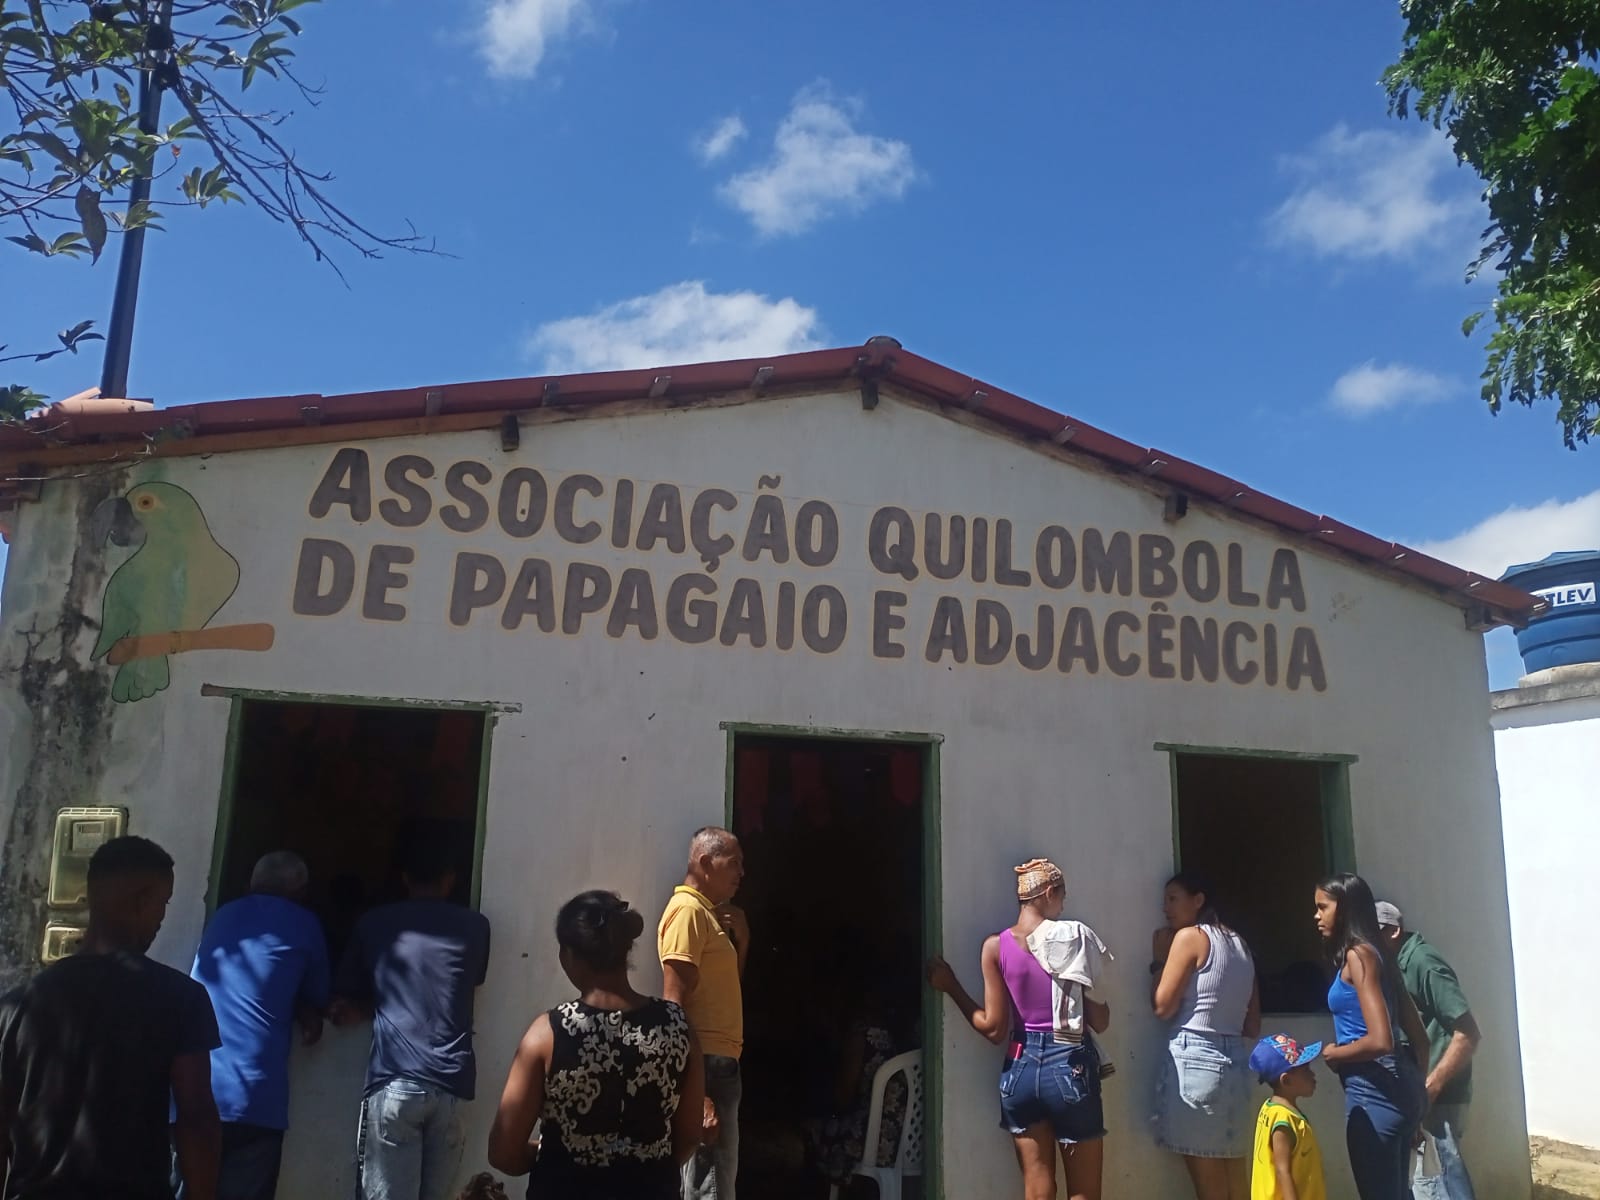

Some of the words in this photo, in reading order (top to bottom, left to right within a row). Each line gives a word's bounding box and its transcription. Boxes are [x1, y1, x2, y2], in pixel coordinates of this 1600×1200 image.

[308, 447, 839, 573] ASSOCIAÇÃO
[868, 506, 1307, 612] QUILOMBOLA
[1544, 587, 1593, 606] TLEV
[293, 537, 415, 622] DE
[449, 551, 848, 654] PAPAGAIO
[873, 590, 908, 659] E
[925, 596, 1328, 692] ADJACÊNCIA
